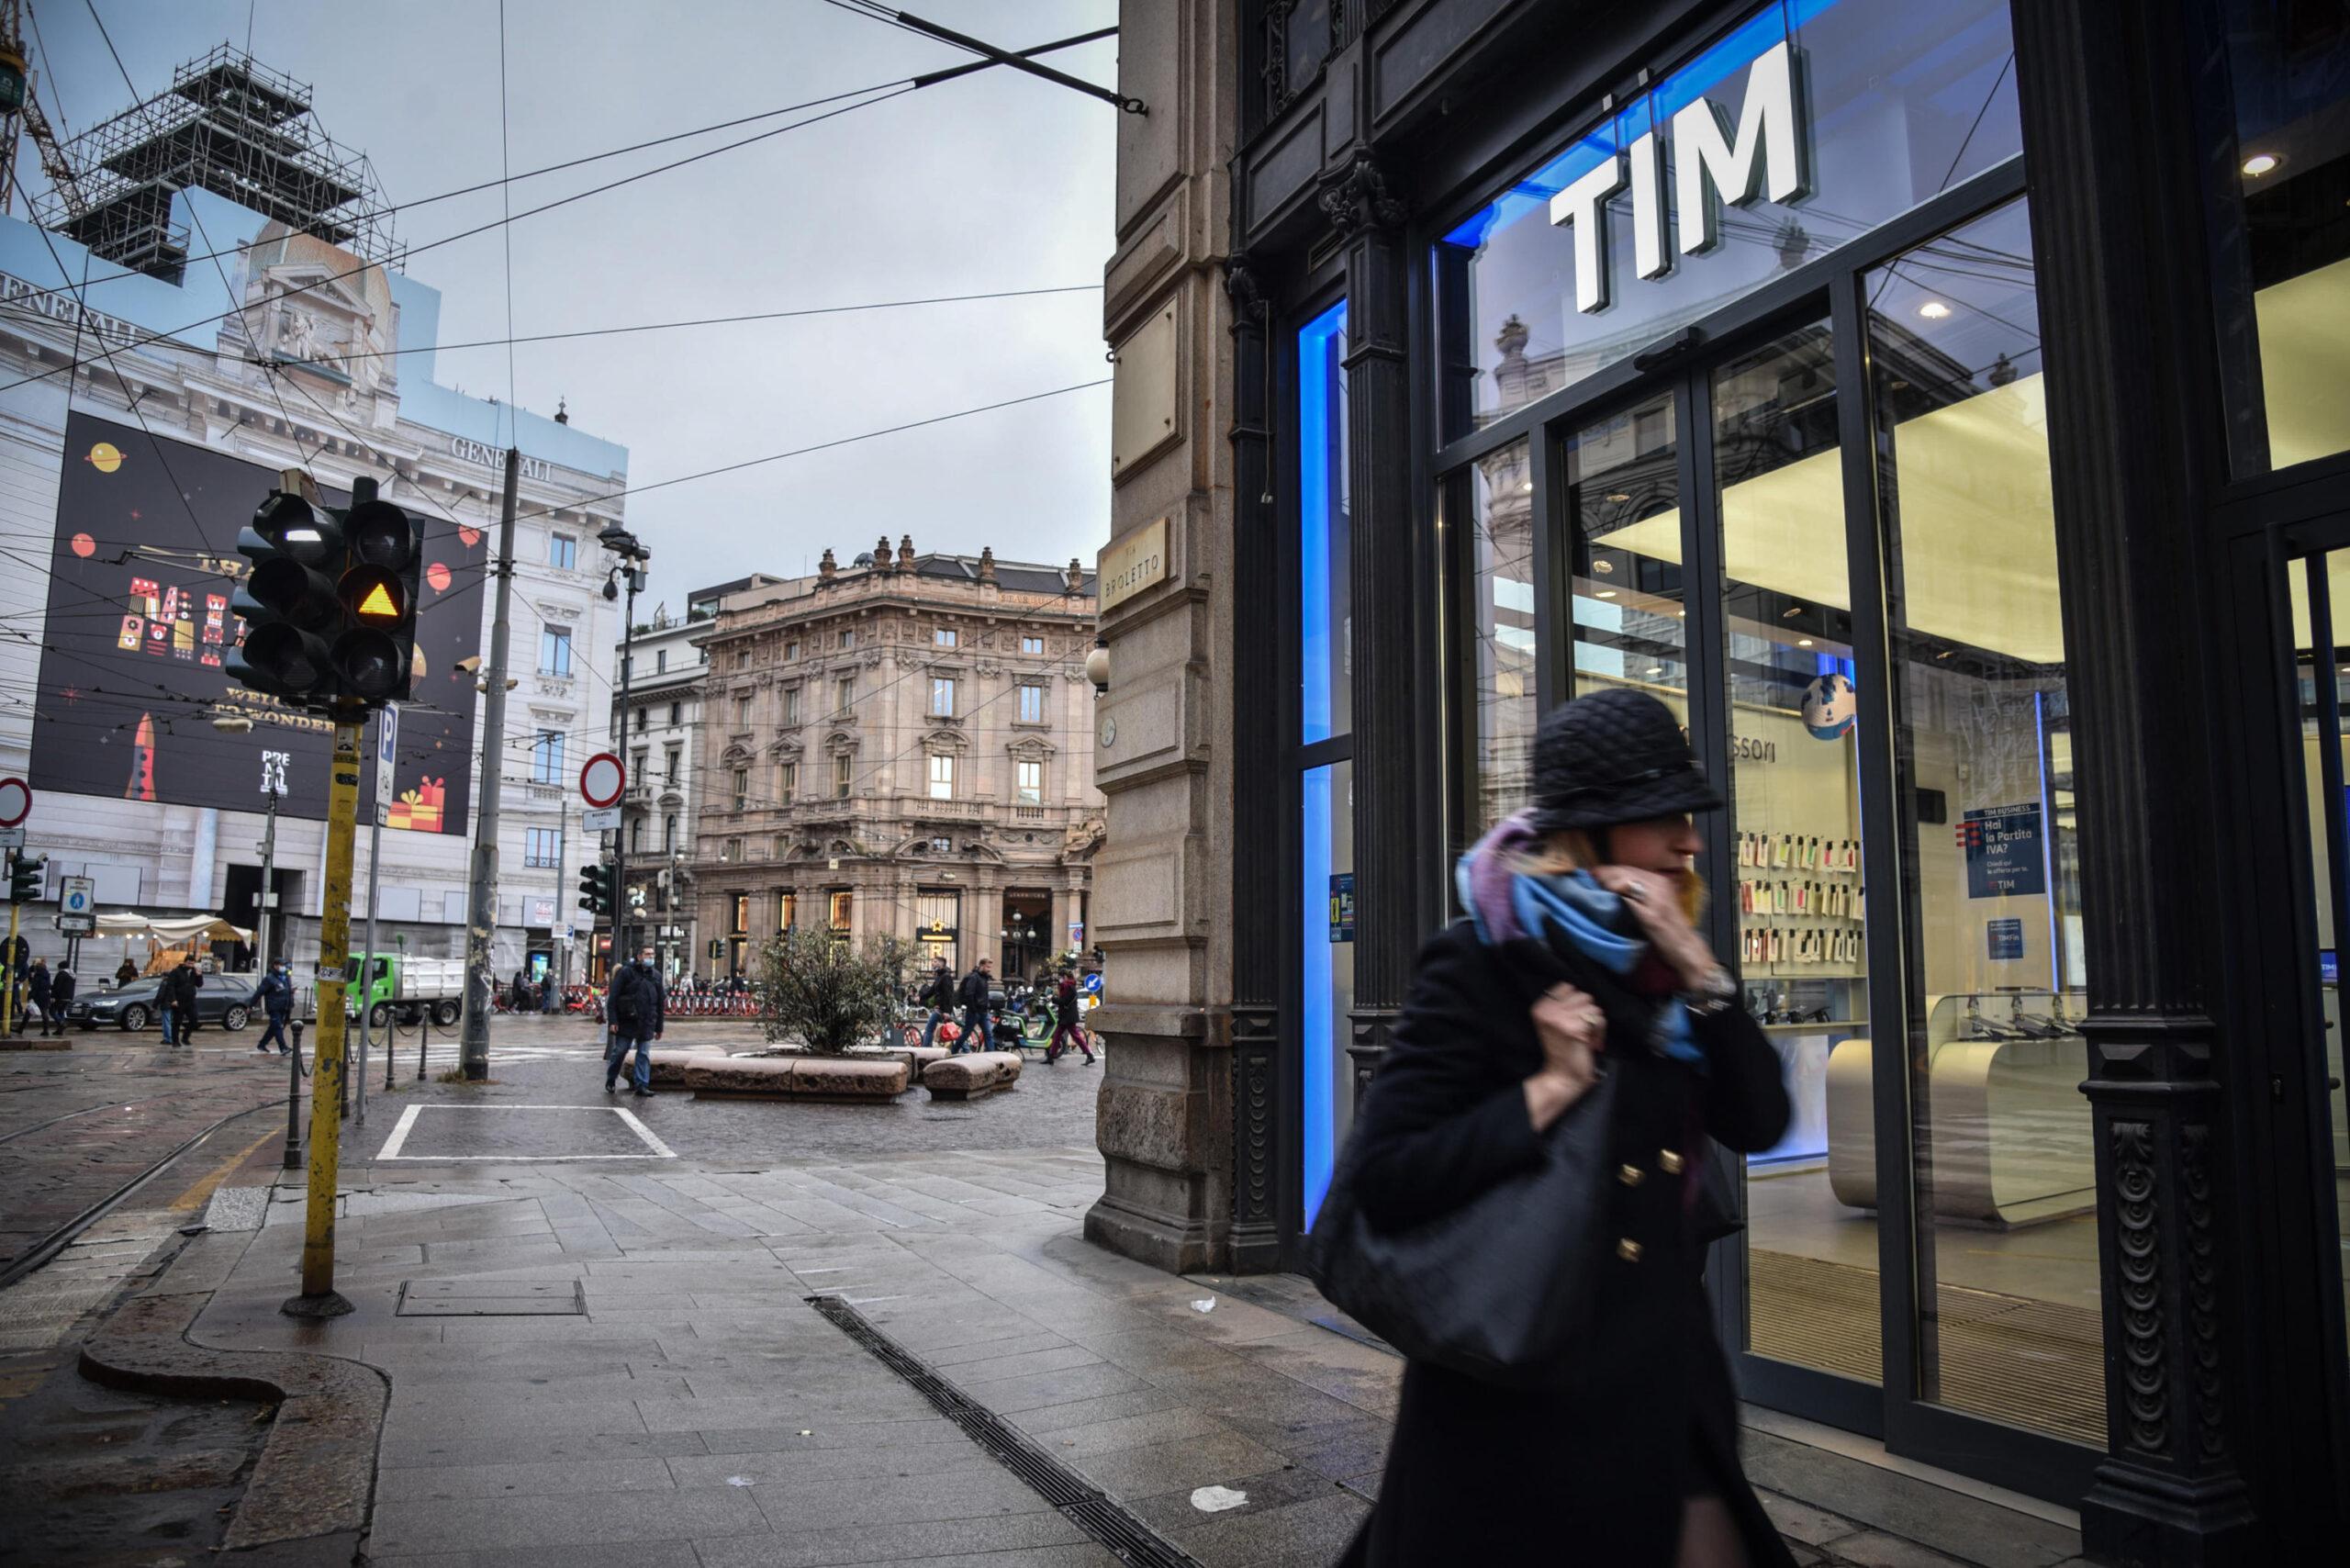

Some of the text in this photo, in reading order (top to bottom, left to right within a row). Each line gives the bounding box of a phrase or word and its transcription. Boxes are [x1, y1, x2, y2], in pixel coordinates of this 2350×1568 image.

[1550, 40, 1807, 314] TIM
[452, 437, 552, 482] GENEALI
[1105, 554, 1158, 598] BROLETTO
[262, 750, 291, 767] PRE
[1984, 805, 2031, 817] TIM BUSINESS
[1985, 819, 2002, 831] Hai
[1998, 829, 2032, 842] Partita
[1986, 843, 2009, 855] IVA?
[1998, 879, 2015, 890] TIM
